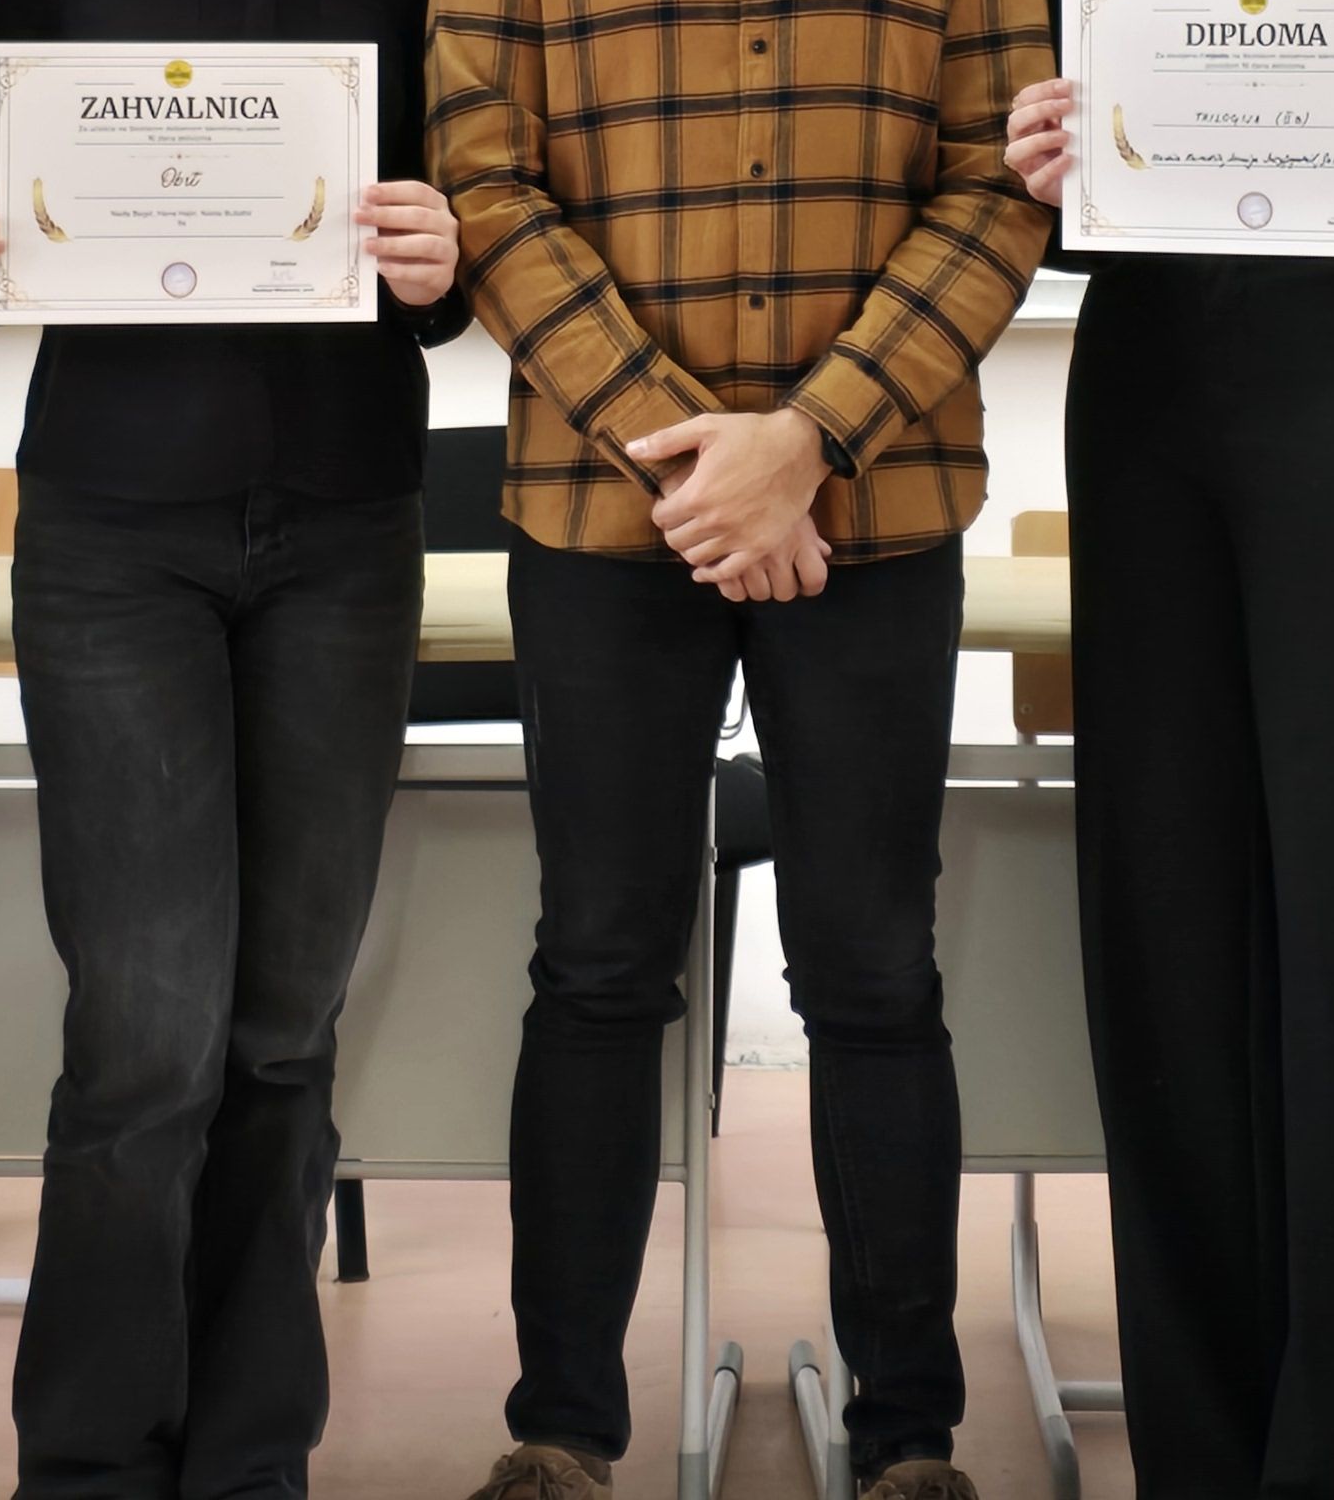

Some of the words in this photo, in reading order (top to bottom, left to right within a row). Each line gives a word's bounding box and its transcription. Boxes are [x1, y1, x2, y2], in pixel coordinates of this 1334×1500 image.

[1185, 22, 1328, 48] DIPLOMA
[80, 96, 280, 120] ZAHVALNICA
[160, 166, 204, 189] Obrt
